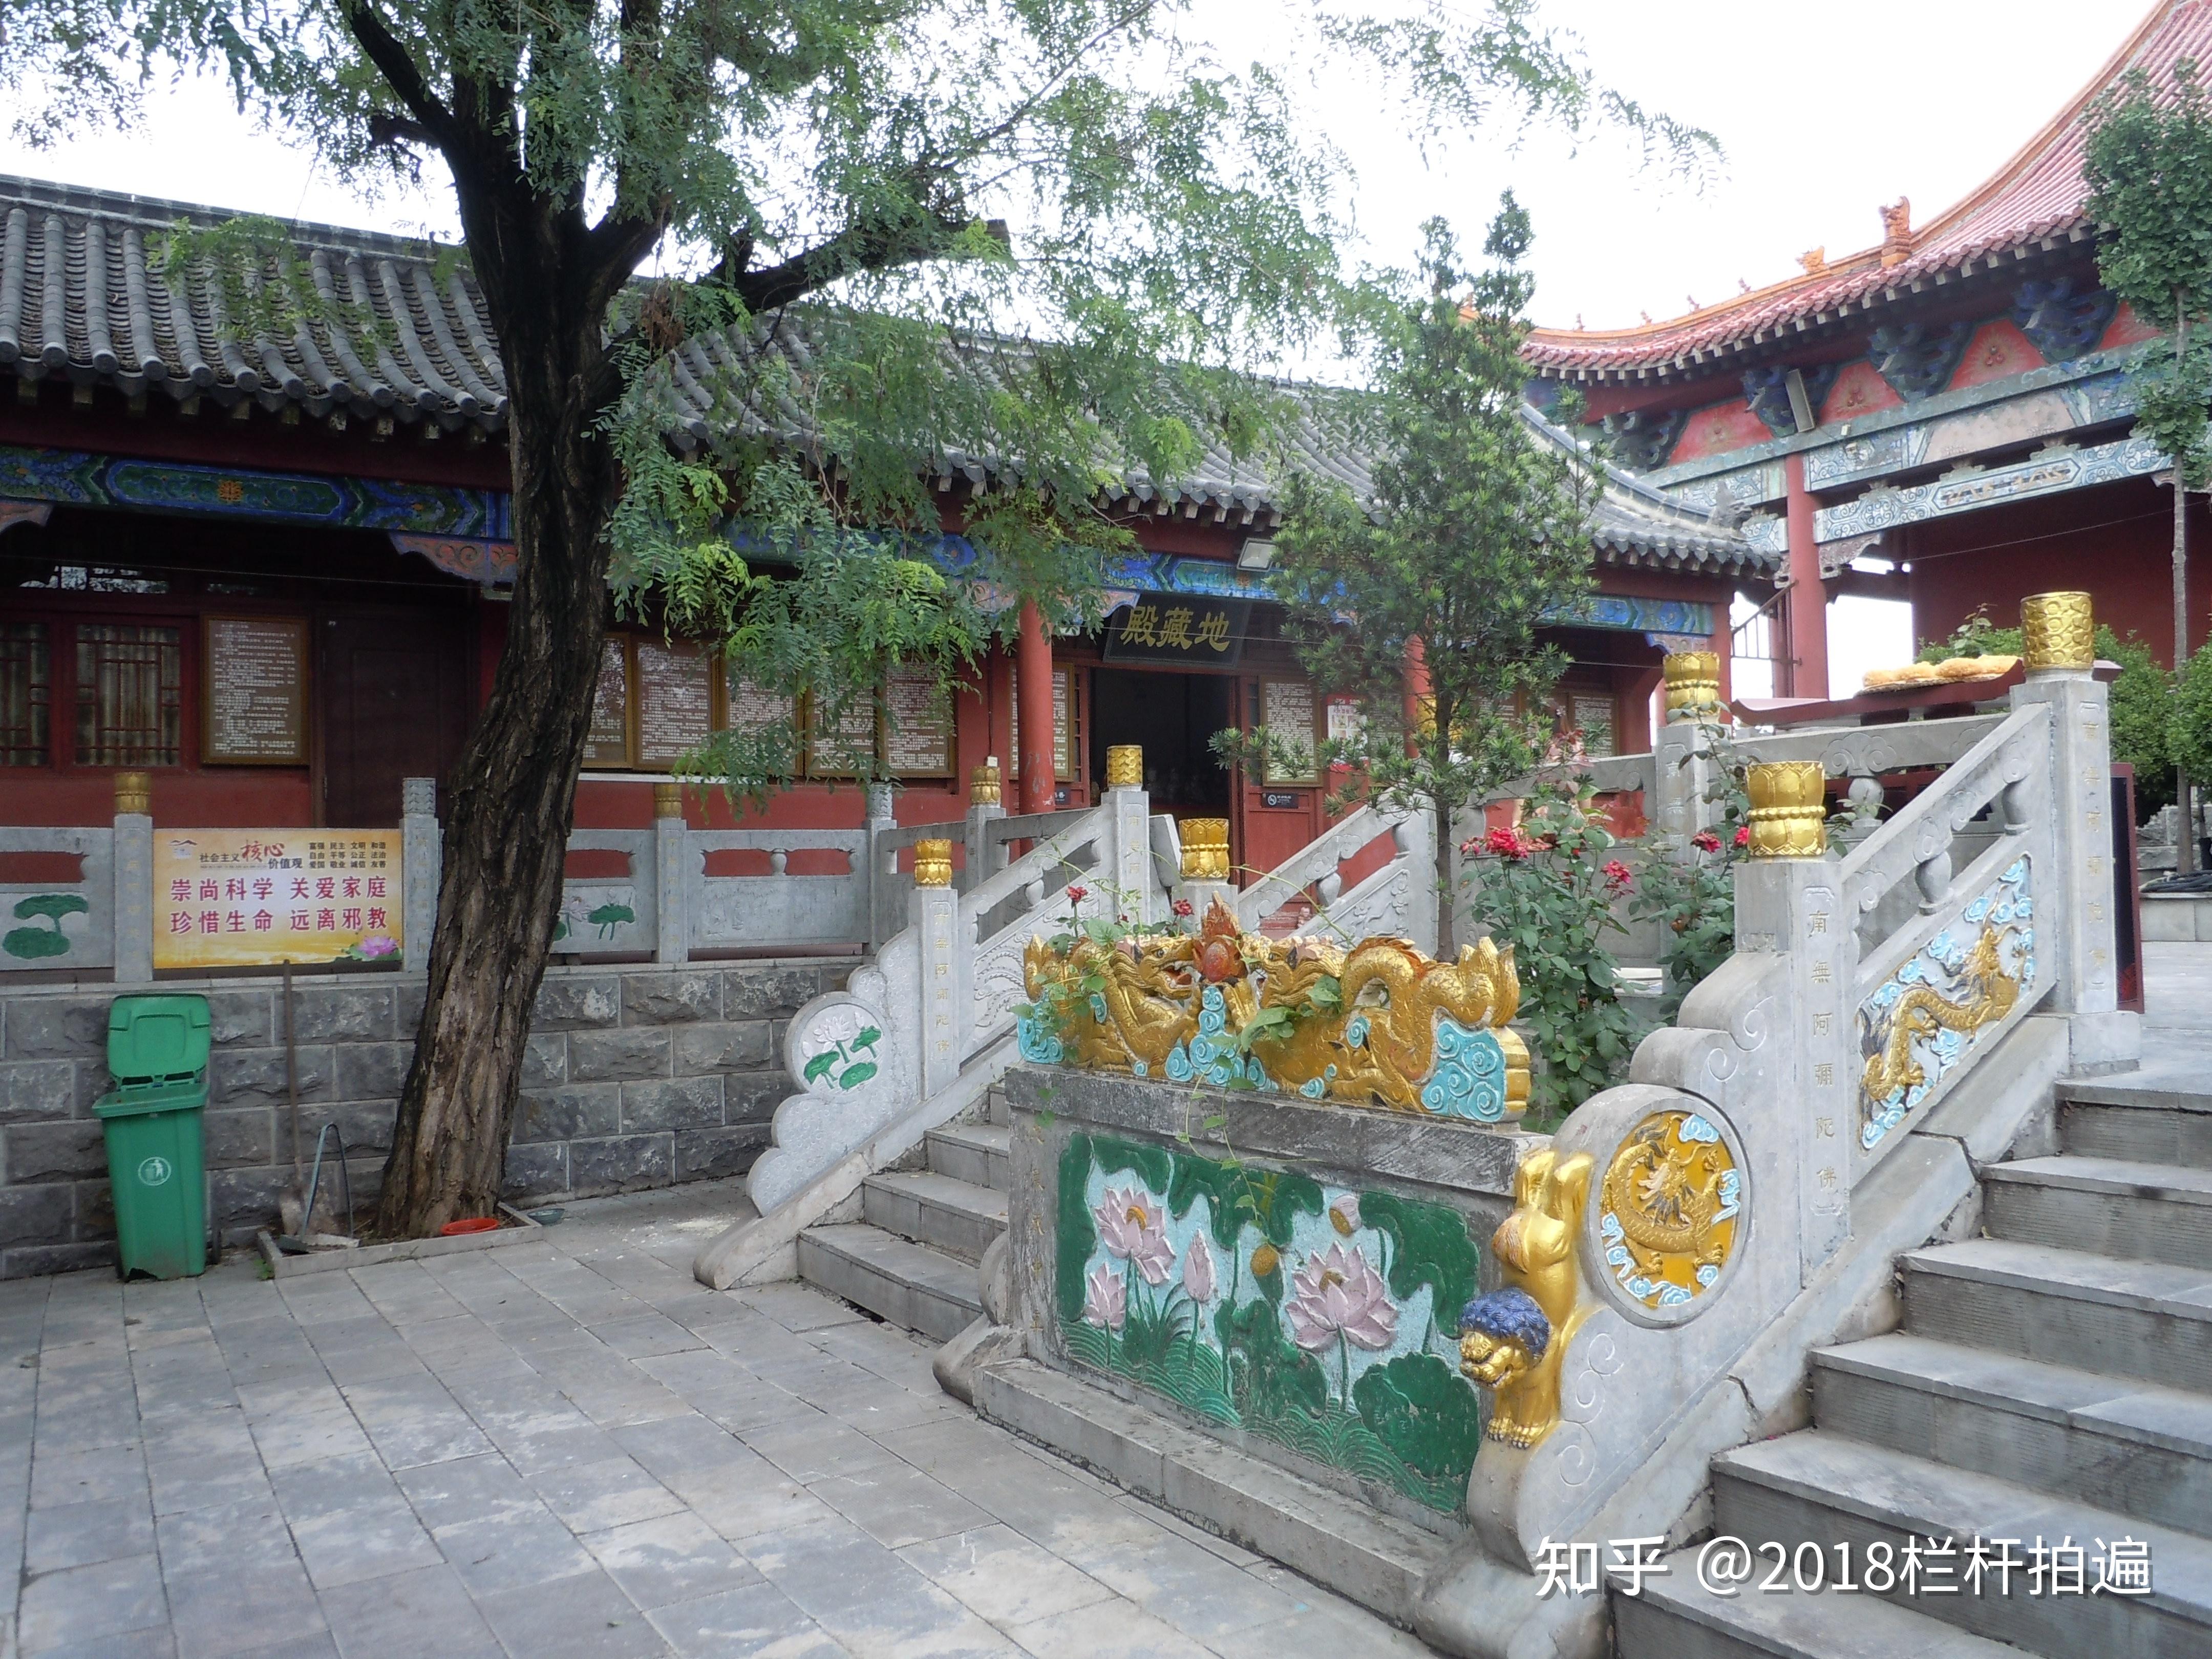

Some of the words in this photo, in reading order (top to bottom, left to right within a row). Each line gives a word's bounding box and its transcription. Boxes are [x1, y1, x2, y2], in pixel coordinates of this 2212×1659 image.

[200, 853, 240, 863] 社会主义
[241, 840, 285, 862] 核心
[268, 858, 303, 869] 价值观
[171, 878, 273, 902] 崇尚科学
[290, 875, 387, 900] 关爱家庭
[170, 909, 274, 934] 珍惜生命
[290, 907, 388, 931] 远离邪教
[1809, 910, 1837, 1189] 南無阿彌陀佛
